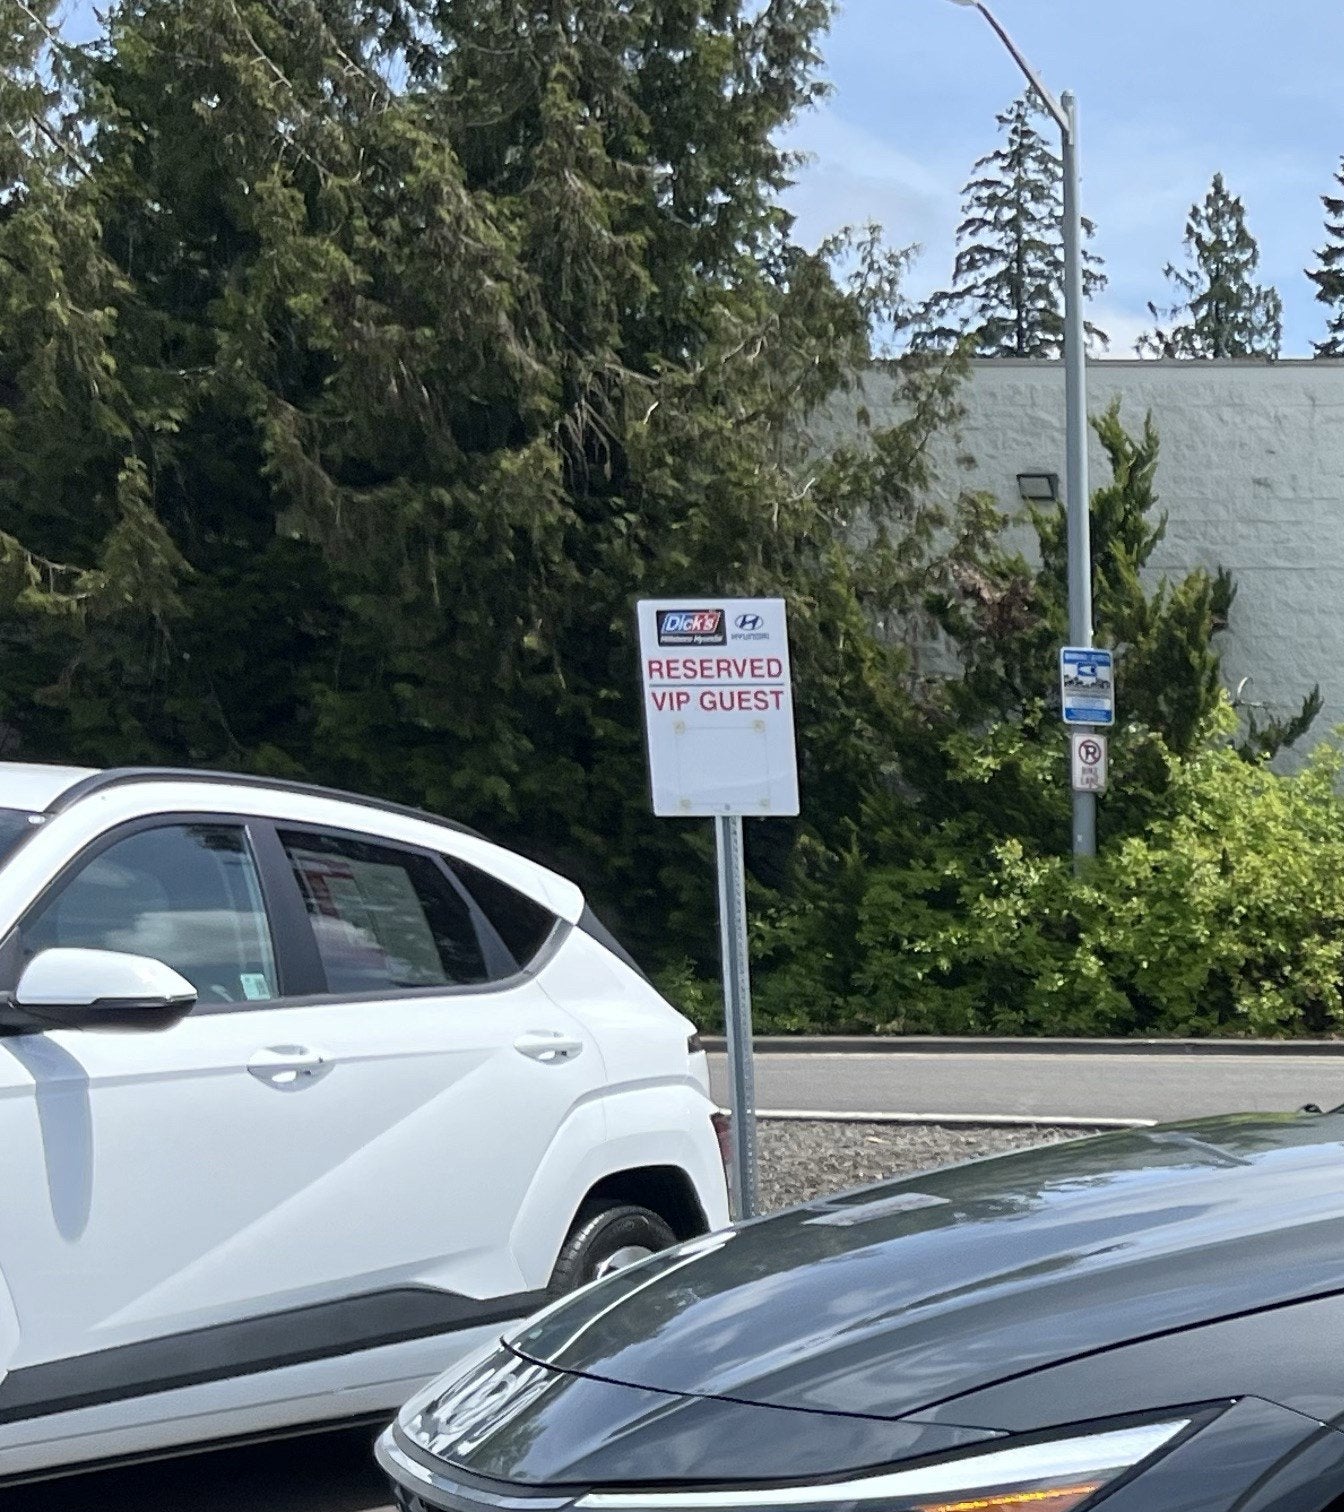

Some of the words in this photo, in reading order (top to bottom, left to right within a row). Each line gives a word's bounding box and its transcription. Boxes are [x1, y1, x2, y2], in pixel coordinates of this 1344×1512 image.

[648, 658, 783, 680] RESERVED
[652, 692, 691, 711] VIP
[699, 690, 784, 711] GUEST
